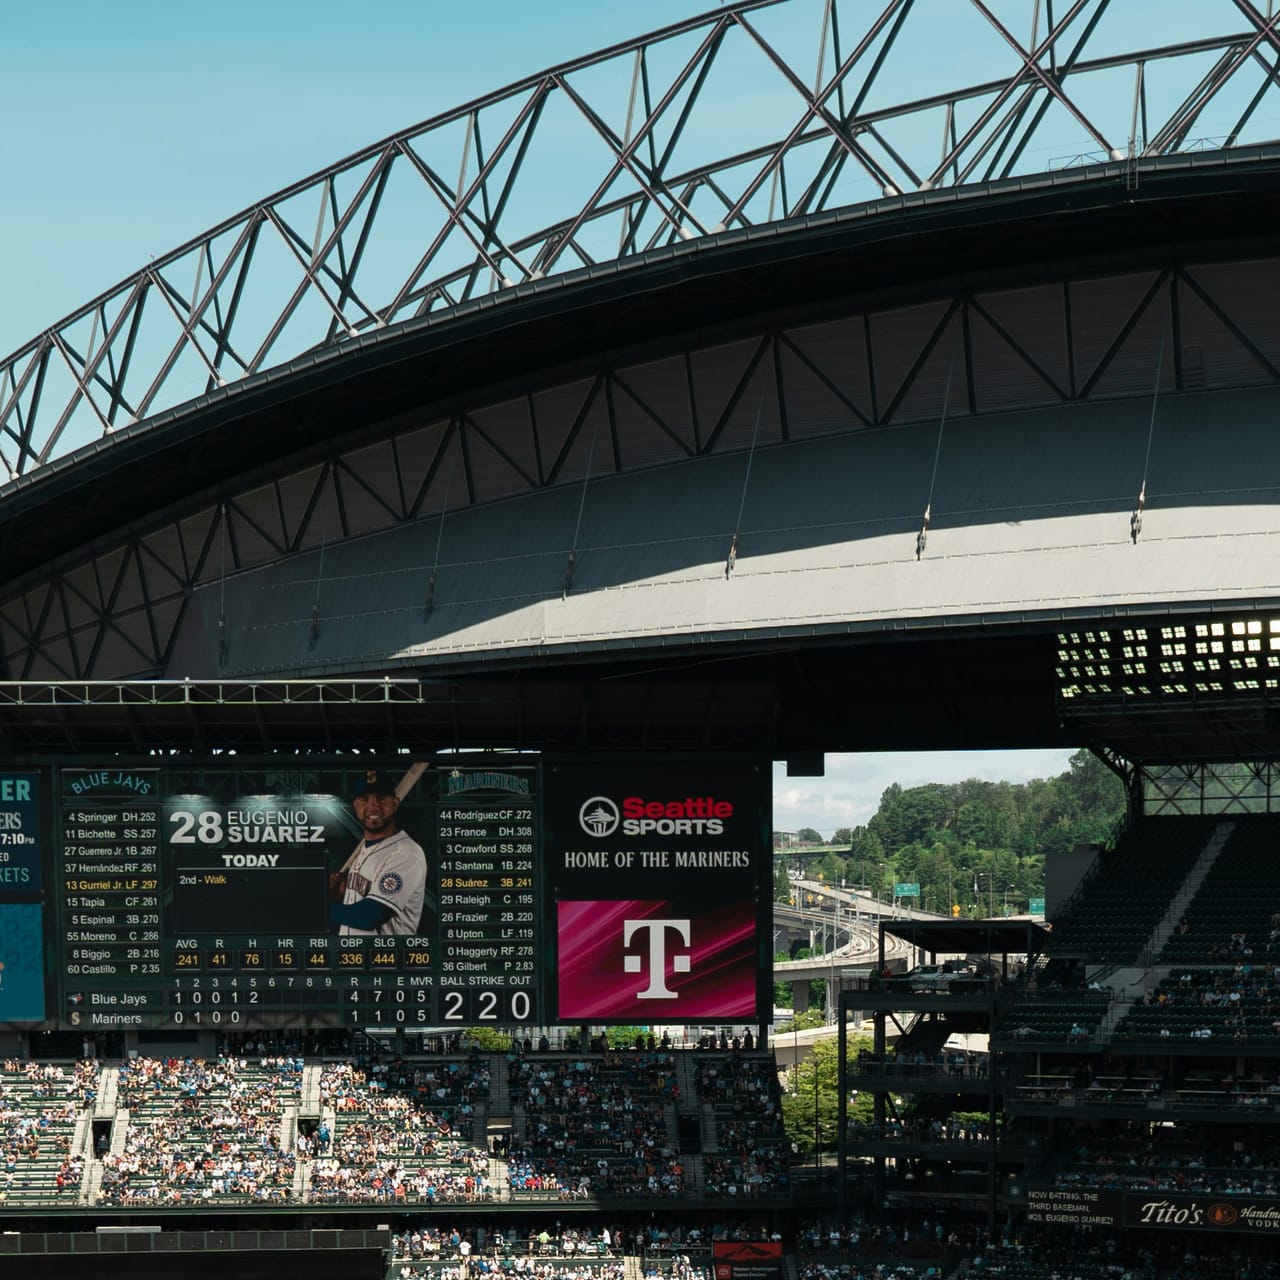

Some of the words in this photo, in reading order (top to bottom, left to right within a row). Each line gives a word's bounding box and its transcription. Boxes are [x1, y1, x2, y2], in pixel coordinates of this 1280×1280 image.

[71, 772, 109, 795] BLUE
[113, 772, 152, 795] JAYS
[448, 770, 529, 796] MARINERS
[623, 797, 734, 818] Seattle
[77, 812, 118, 824] Springer
[227, 811, 308, 825] EUGENIO
[170, 811, 224, 844] 28
[454, 827, 487, 837] France
[623, 819, 724, 835] SPORTS
[78, 829, 117, 839] Bichette
[78, 846, 112, 856] Guerrero
[454, 844, 497, 854] Crawford
[222, 854, 280, 867] TODAY
[565, 852, 609, 868] HOME
[614, 852, 635, 868] OF
[640, 852, 669, 868] THE
[675, 851, 750, 868] MARINERS
[455, 861, 494, 871] Santana
[79, 881, 111, 890] Gurriel
[204, 875, 227, 885] Walk
[80, 897, 106, 909] Tapia
[455, 895, 491, 907] Raleigh
[80, 915, 115, 926] Espinal
[455, 913, 488, 922] Frazier
[80, 932, 117, 941] Moreno
[455, 929, 484, 941] Upton
[175, 939, 198, 949] AVG
[309, 938, 328, 948] RBI
[340, 938, 363, 948] OBP
[374, 938, 396, 948] SLG
[406, 938, 430, 947] OPS
[81, 949, 111, 961] Biggio
[456, 946, 498, 958] Haggerty
[624, 919, 691, 999] T
[81, 965, 117, 974] Castillo
[456, 961, 488, 971] Gilbert
[440, 976, 466, 986] BALL
[468, 976, 505, 986] STRIKE
[509, 976, 531, 985] OUT
[91, 994, 118, 1004] Blue
[120, 994, 148, 1007] Jays
[445, 992, 464, 1019] 2
[478, 992, 497, 1019] 2
[511, 991, 530, 1019] 0
[92, 1013, 143, 1024] Mariners
